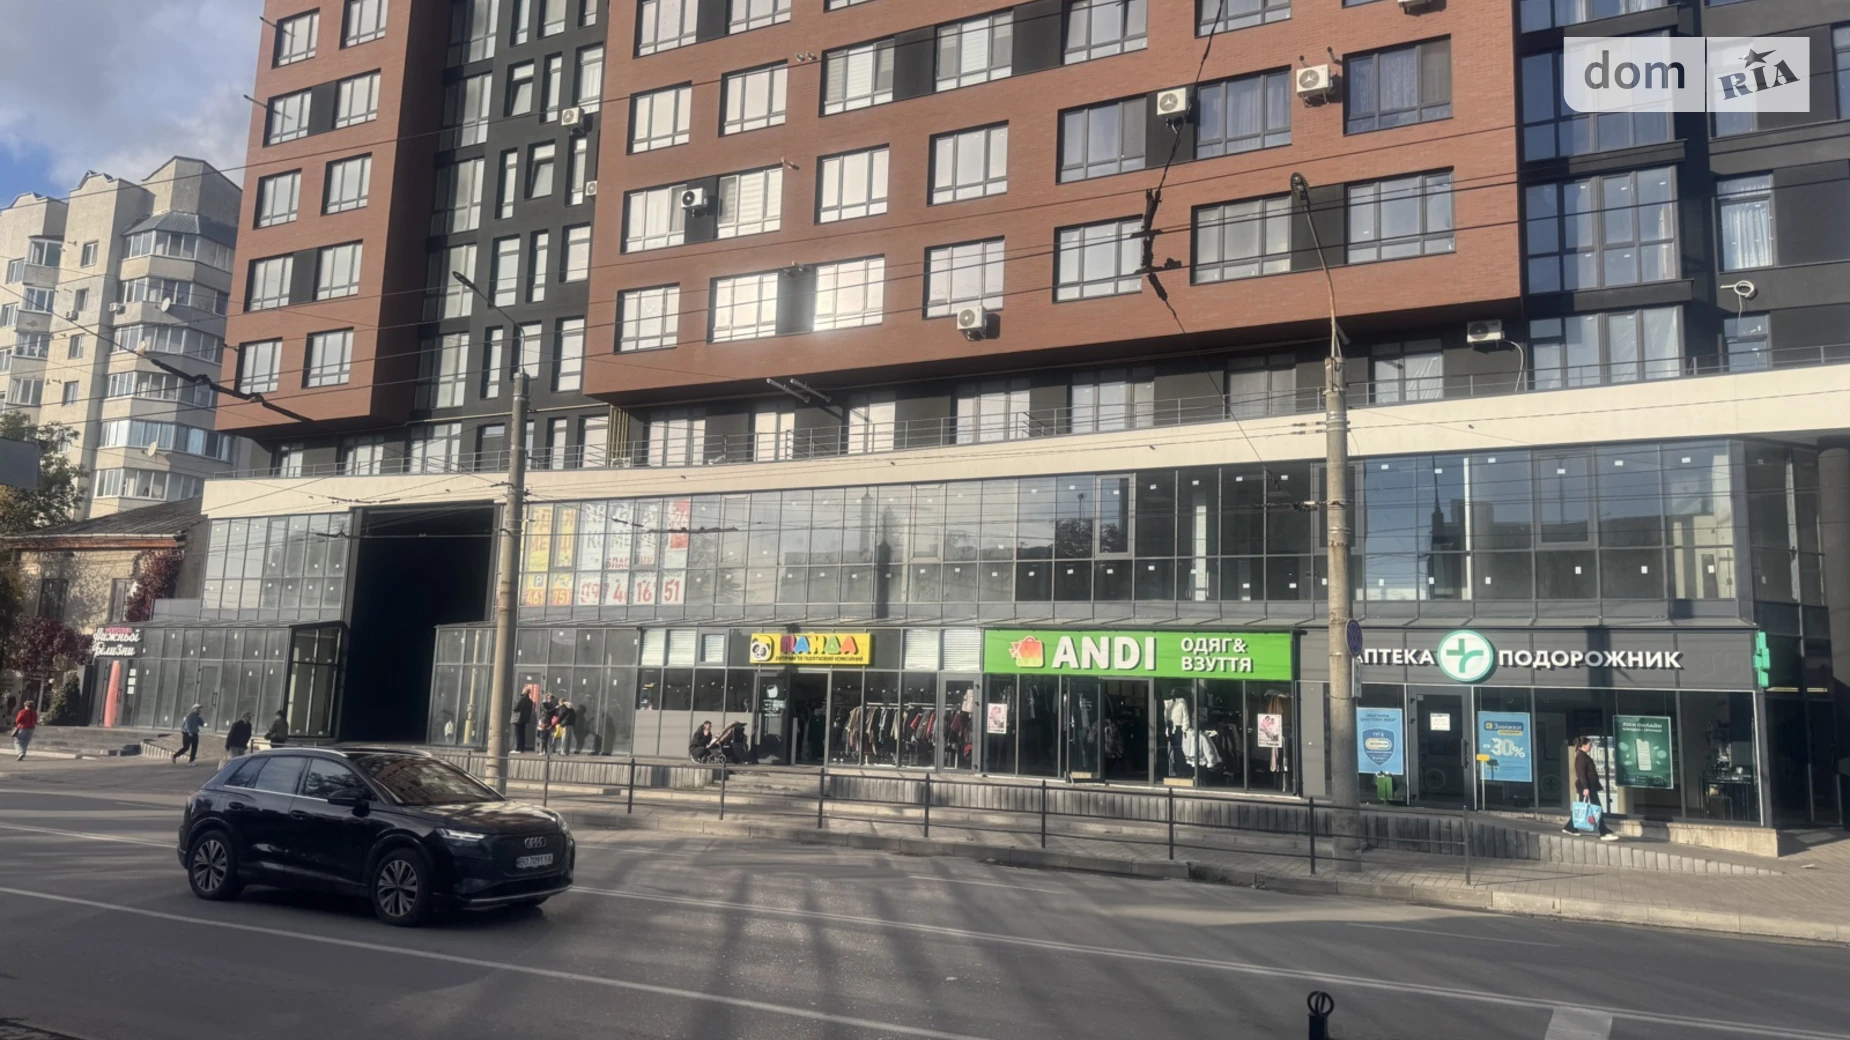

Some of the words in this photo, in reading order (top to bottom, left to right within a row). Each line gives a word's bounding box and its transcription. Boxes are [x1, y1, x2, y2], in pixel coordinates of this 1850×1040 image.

[664, 581, 680, 602] 51
[780, 635, 858, 655] ПАНДА
[1051, 636, 1156, 670] ANDI
[1180, 637, 1246, 654] ОДЯГ&
[1181, 656, 1252, 672] ВЗУТТЯ
[1499, 649, 1682, 668] ПОДОРОЖНИК
